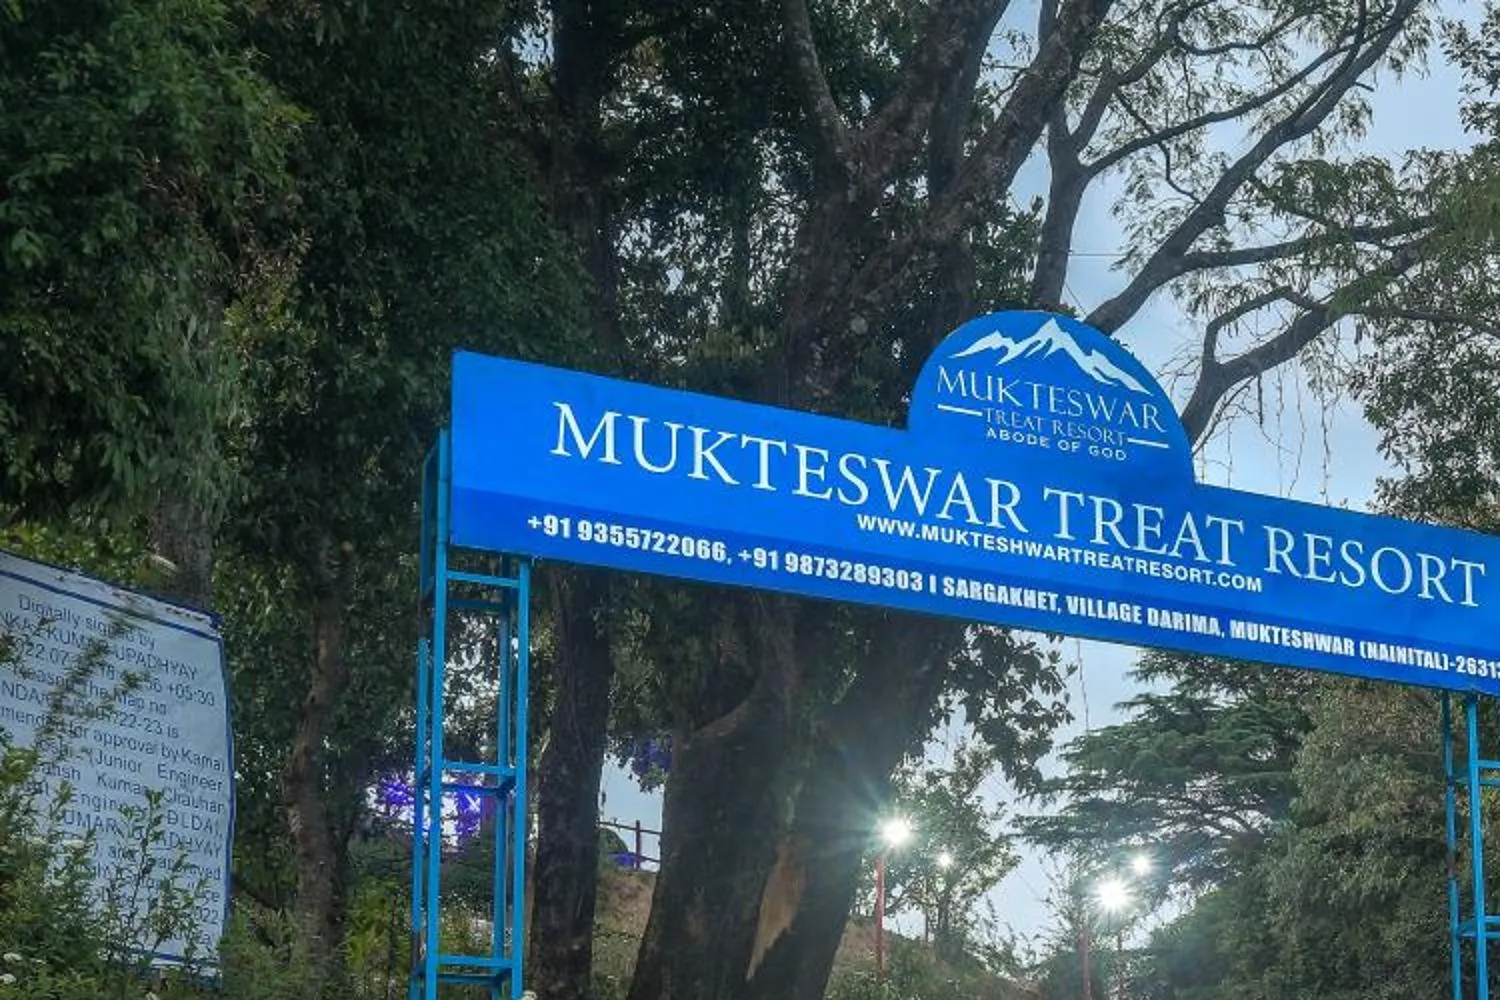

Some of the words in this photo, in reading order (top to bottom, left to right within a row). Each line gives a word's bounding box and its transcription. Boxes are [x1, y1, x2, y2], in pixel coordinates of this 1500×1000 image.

[937, 365, 1166, 432] MUKTESWAR
[983, 407, 1045, 430] TREAT
[1053, 417, 1127, 446] RESORT
[986, 427, 1049, 448] ABODE
[1058, 439, 1080, 453] OF
[1089, 445, 1127, 461] GOD
[550, 402, 1028, 533] MUKTESWAR
[1043, 488, 1244, 567] TREAT
[1263, 525, 1486, 607] RESORT
[527, 513, 570, 538] +91
[577, 521, 732, 565] 9355722066,
[737, 548, 780, 571] +91
[785, 554, 924, 592] 9873289303
[943, 578, 1062, 615] SARGAKHET,
[1066, 595, 1142, 625] VILLAGE
[1147, 606, 1225, 638] DARIMA,
[1230, 620, 1355, 657] MUKTESHWAR
[857, 513, 1263, 592] WWW.MUKTESHWARTREATRESORT.COM
